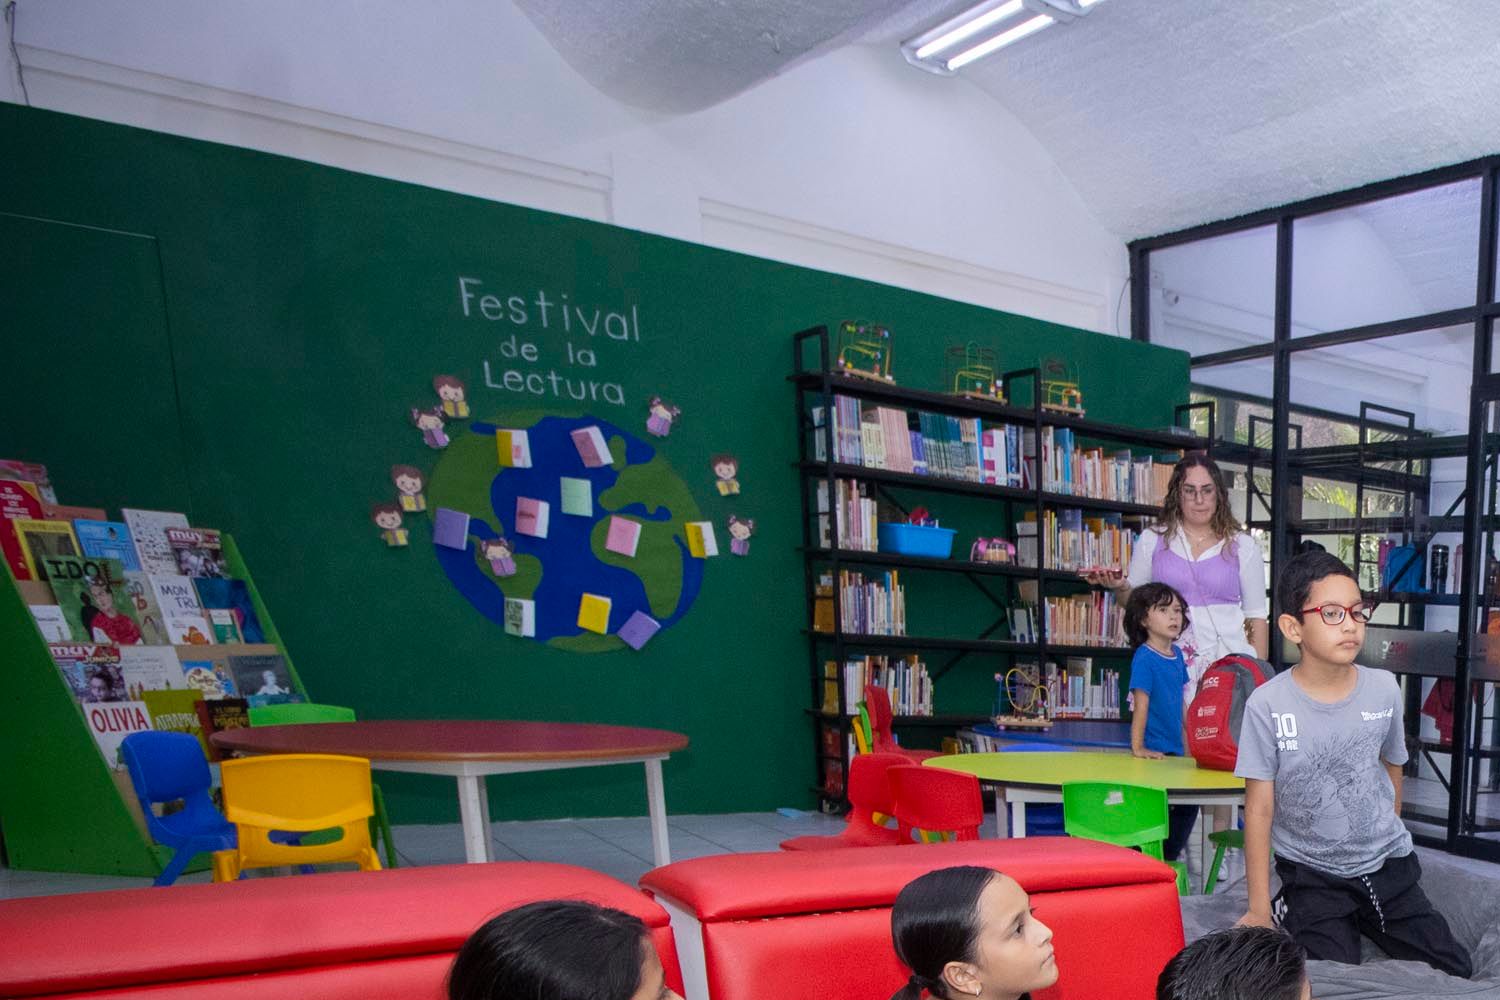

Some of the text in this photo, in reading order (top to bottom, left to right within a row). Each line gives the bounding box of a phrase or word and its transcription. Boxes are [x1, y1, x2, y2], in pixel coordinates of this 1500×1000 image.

[459, 276, 640, 342] Festival
[500, 334, 597, 367] de la
[483, 360, 626, 406] Lectura
[91, 707, 150, 733] OLIVIA
